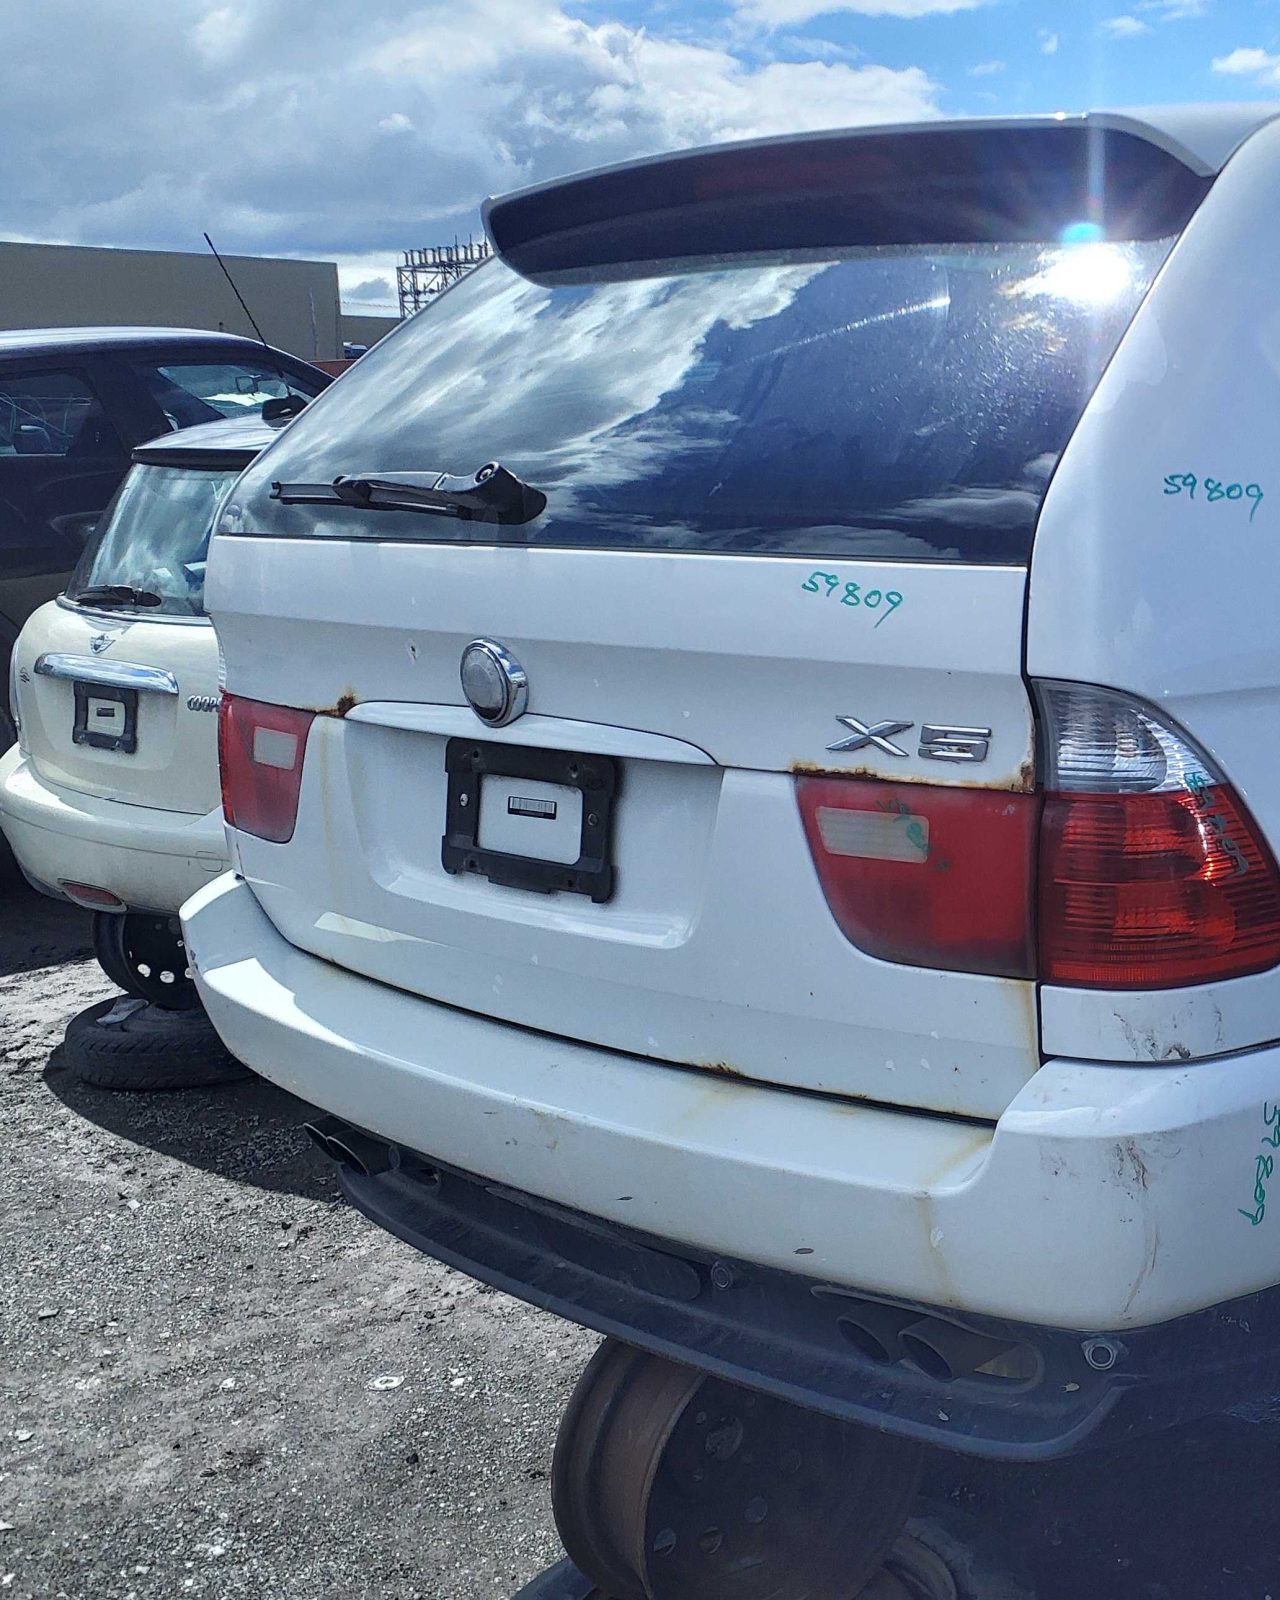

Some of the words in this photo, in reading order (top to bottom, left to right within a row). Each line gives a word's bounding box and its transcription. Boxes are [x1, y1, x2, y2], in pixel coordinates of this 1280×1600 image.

[1163, 472, 1264, 522] 59809
[801, 570, 903, 629] 59809
[825, 714, 993, 764] X5
